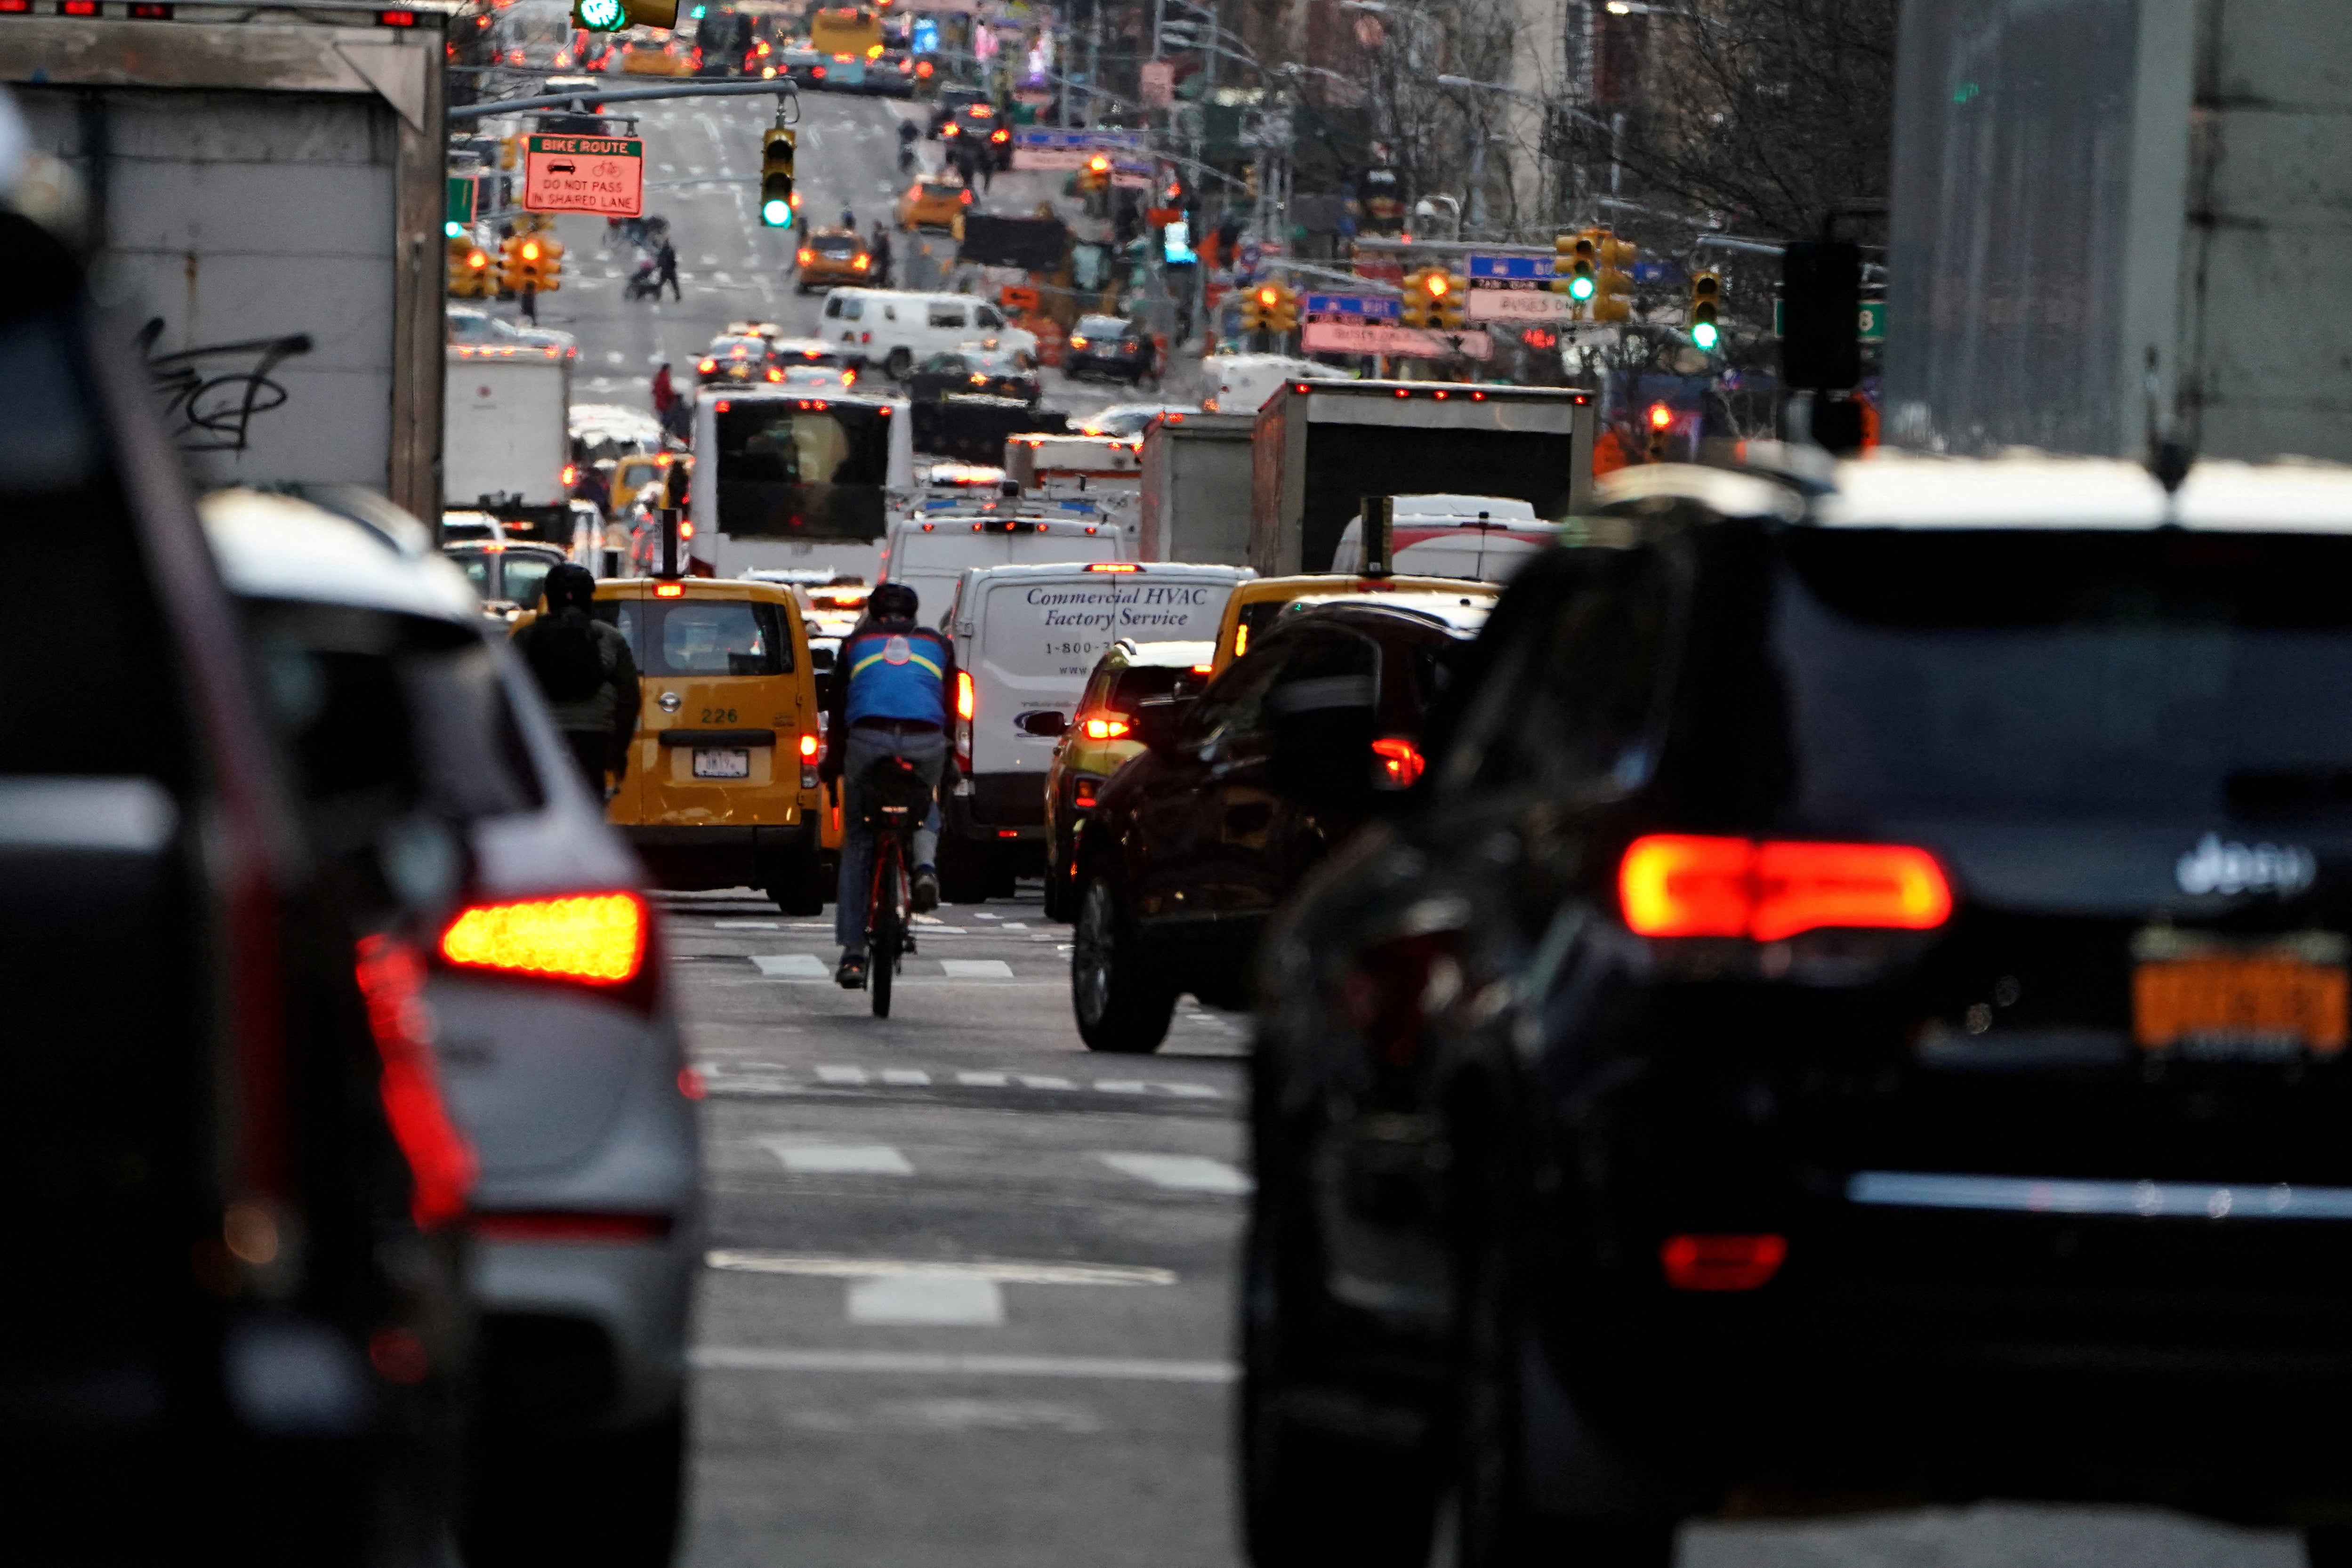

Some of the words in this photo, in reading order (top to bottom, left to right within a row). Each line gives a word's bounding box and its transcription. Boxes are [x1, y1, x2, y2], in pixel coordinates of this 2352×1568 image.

[542, 139, 576, 152] BIKE
[580, 140, 629, 153] ROUTE
[543, 179, 560, 189] DO
[565, 180, 588, 191] NOT
[592, 181, 622, 193] PASS
[533, 192, 543, 203] IN
[549, 194, 596, 206] SHARED
[601, 196, 633, 209] LANE
[1026, 587, 1139, 606] Commercial
[1143, 587, 1208, 605] HVAC
[1045, 609, 1115, 631] Factory
[1120, 607, 1189, 627] Service
[701, 708, 738, 724] 226
